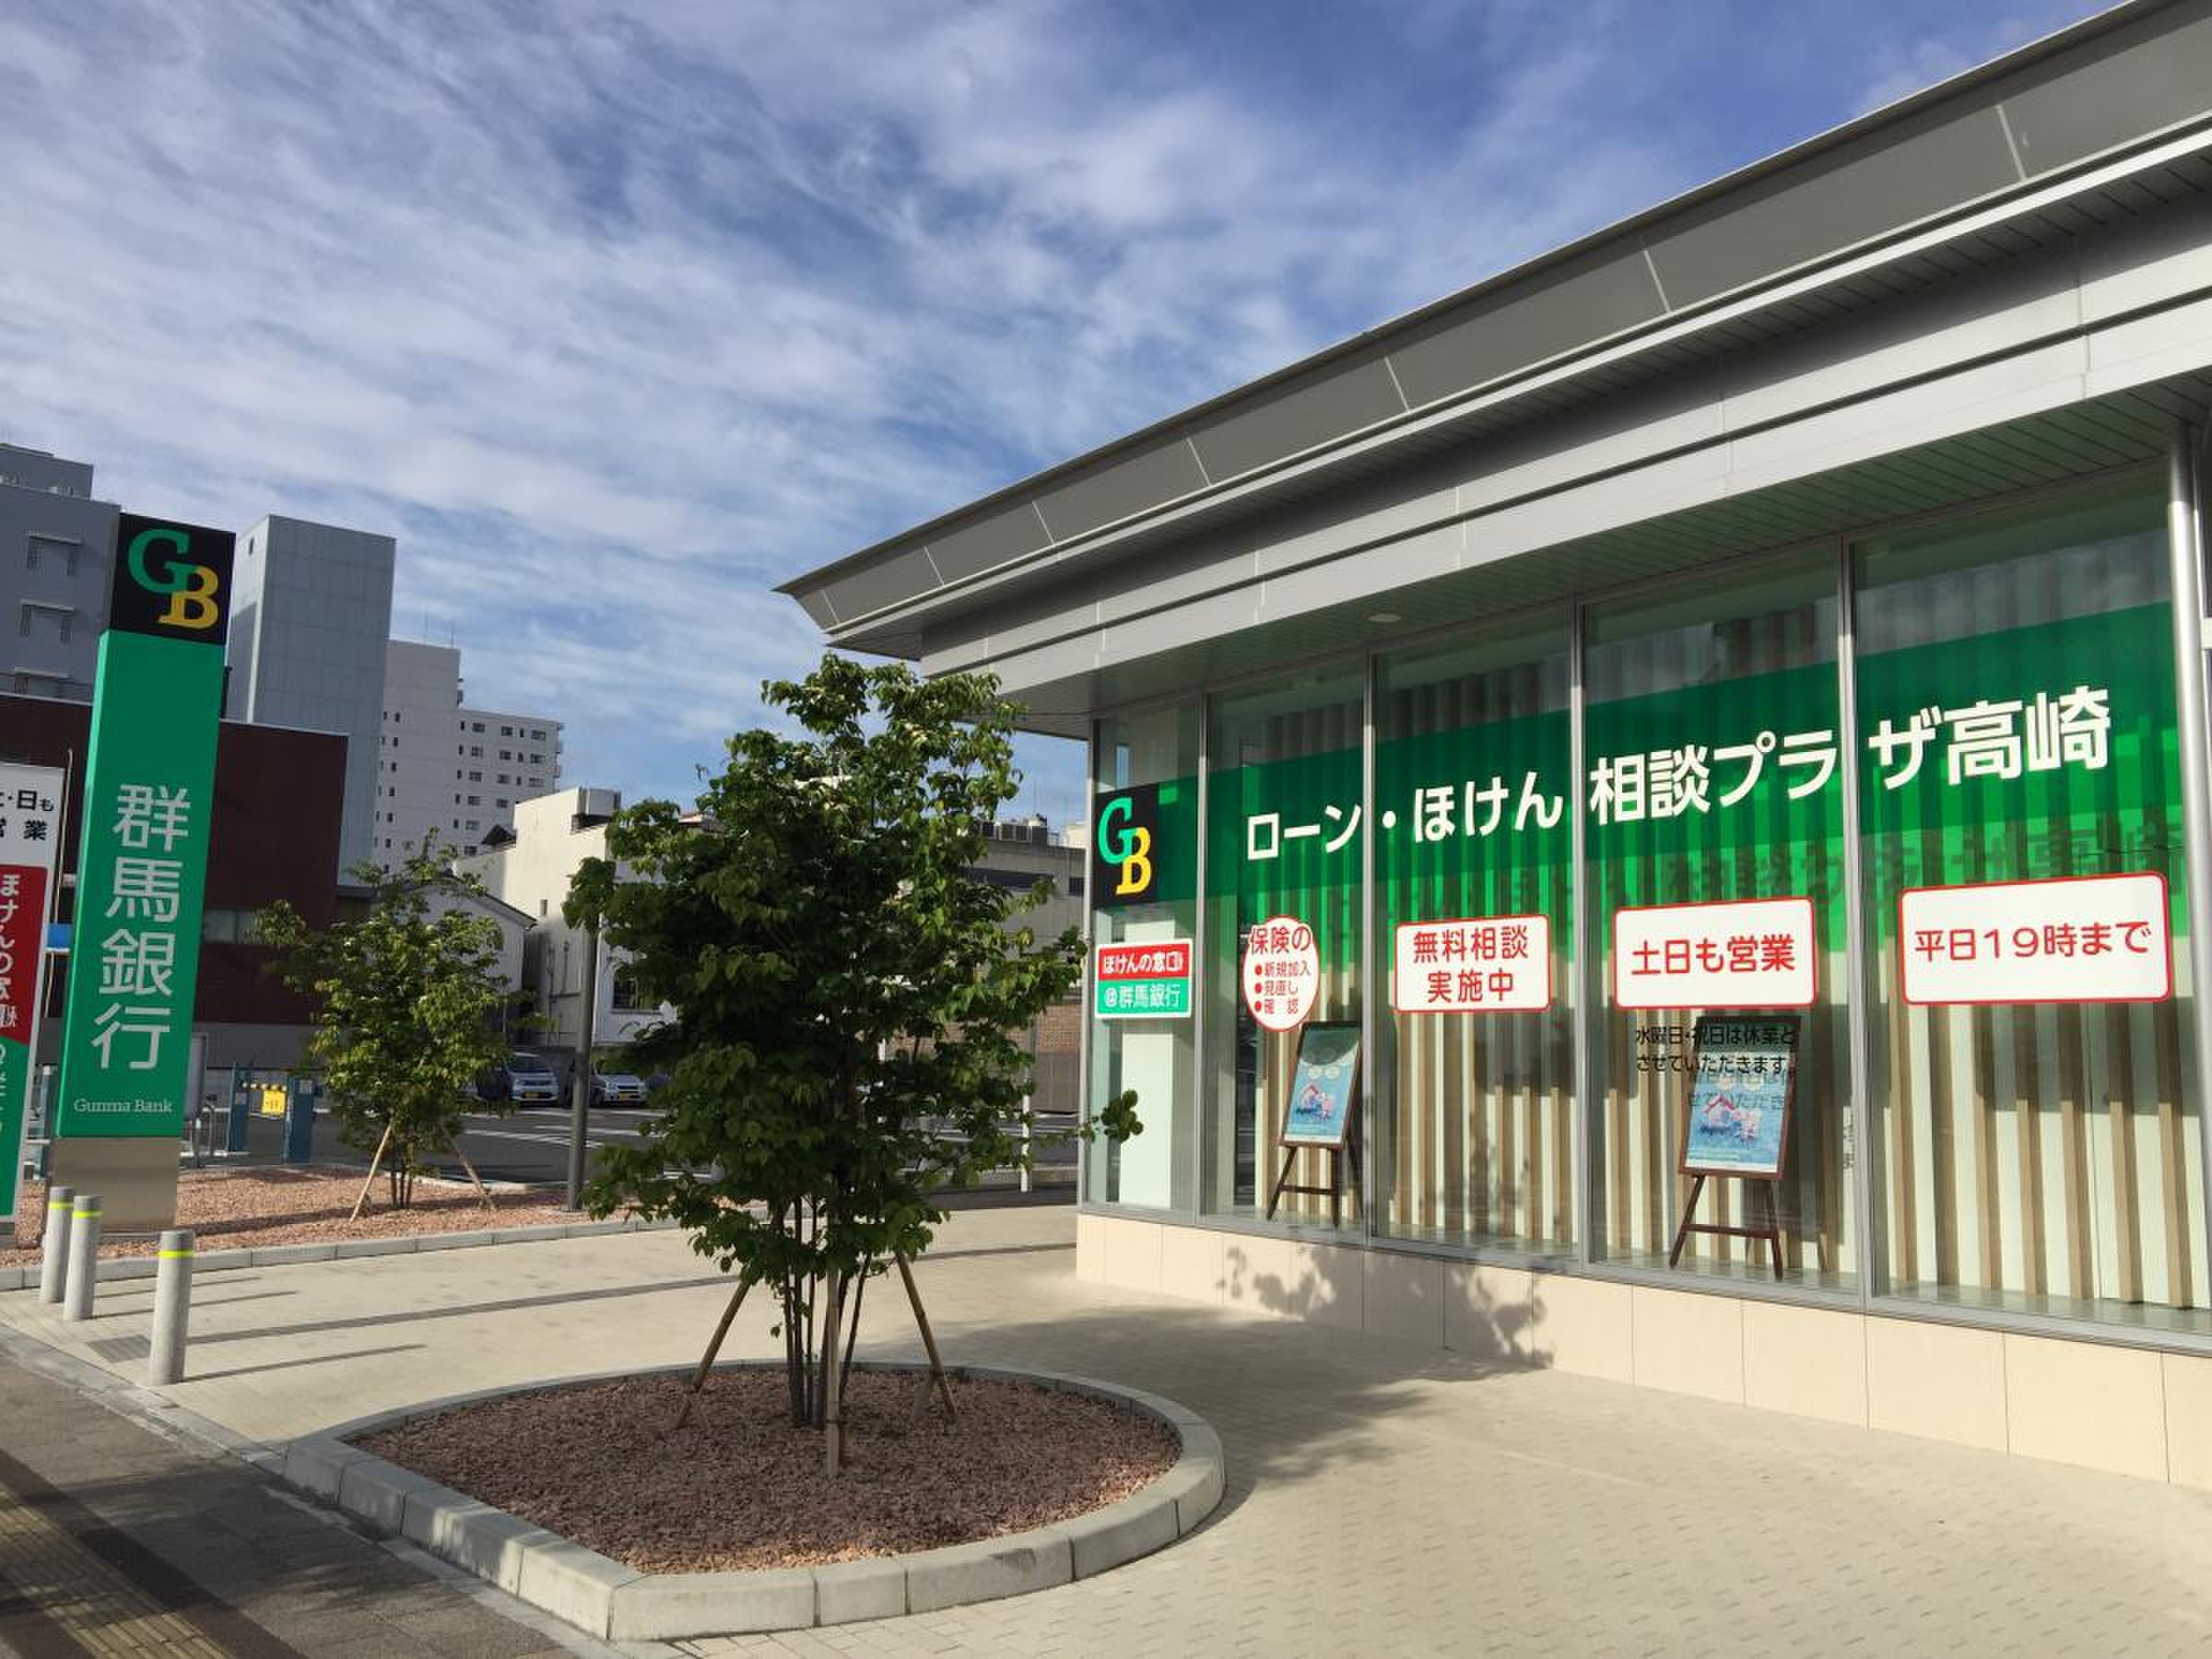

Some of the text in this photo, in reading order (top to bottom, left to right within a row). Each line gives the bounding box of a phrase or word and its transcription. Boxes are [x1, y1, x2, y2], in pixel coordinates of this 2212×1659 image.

[127, 528, 218, 629] GB
[1247, 686, 2111, 861] ローン・ほけん相談プラザ高崎
[1098, 797, 1151, 895] GB
[90, 784, 191, 1071] 群馬銀行
[1251, 926, 1312, 955] 保険の
[1414, 926, 1529, 962] 無料相談
[1914, 921, 2151, 961] 平日19時まで
[1264, 961, 1311, 977] 新規加入
[1631, 934, 1795, 975] 土日も営業
[1428, 969, 1514, 1003] 実施中
[74, 1098, 172, 1113] Gunma Bank
